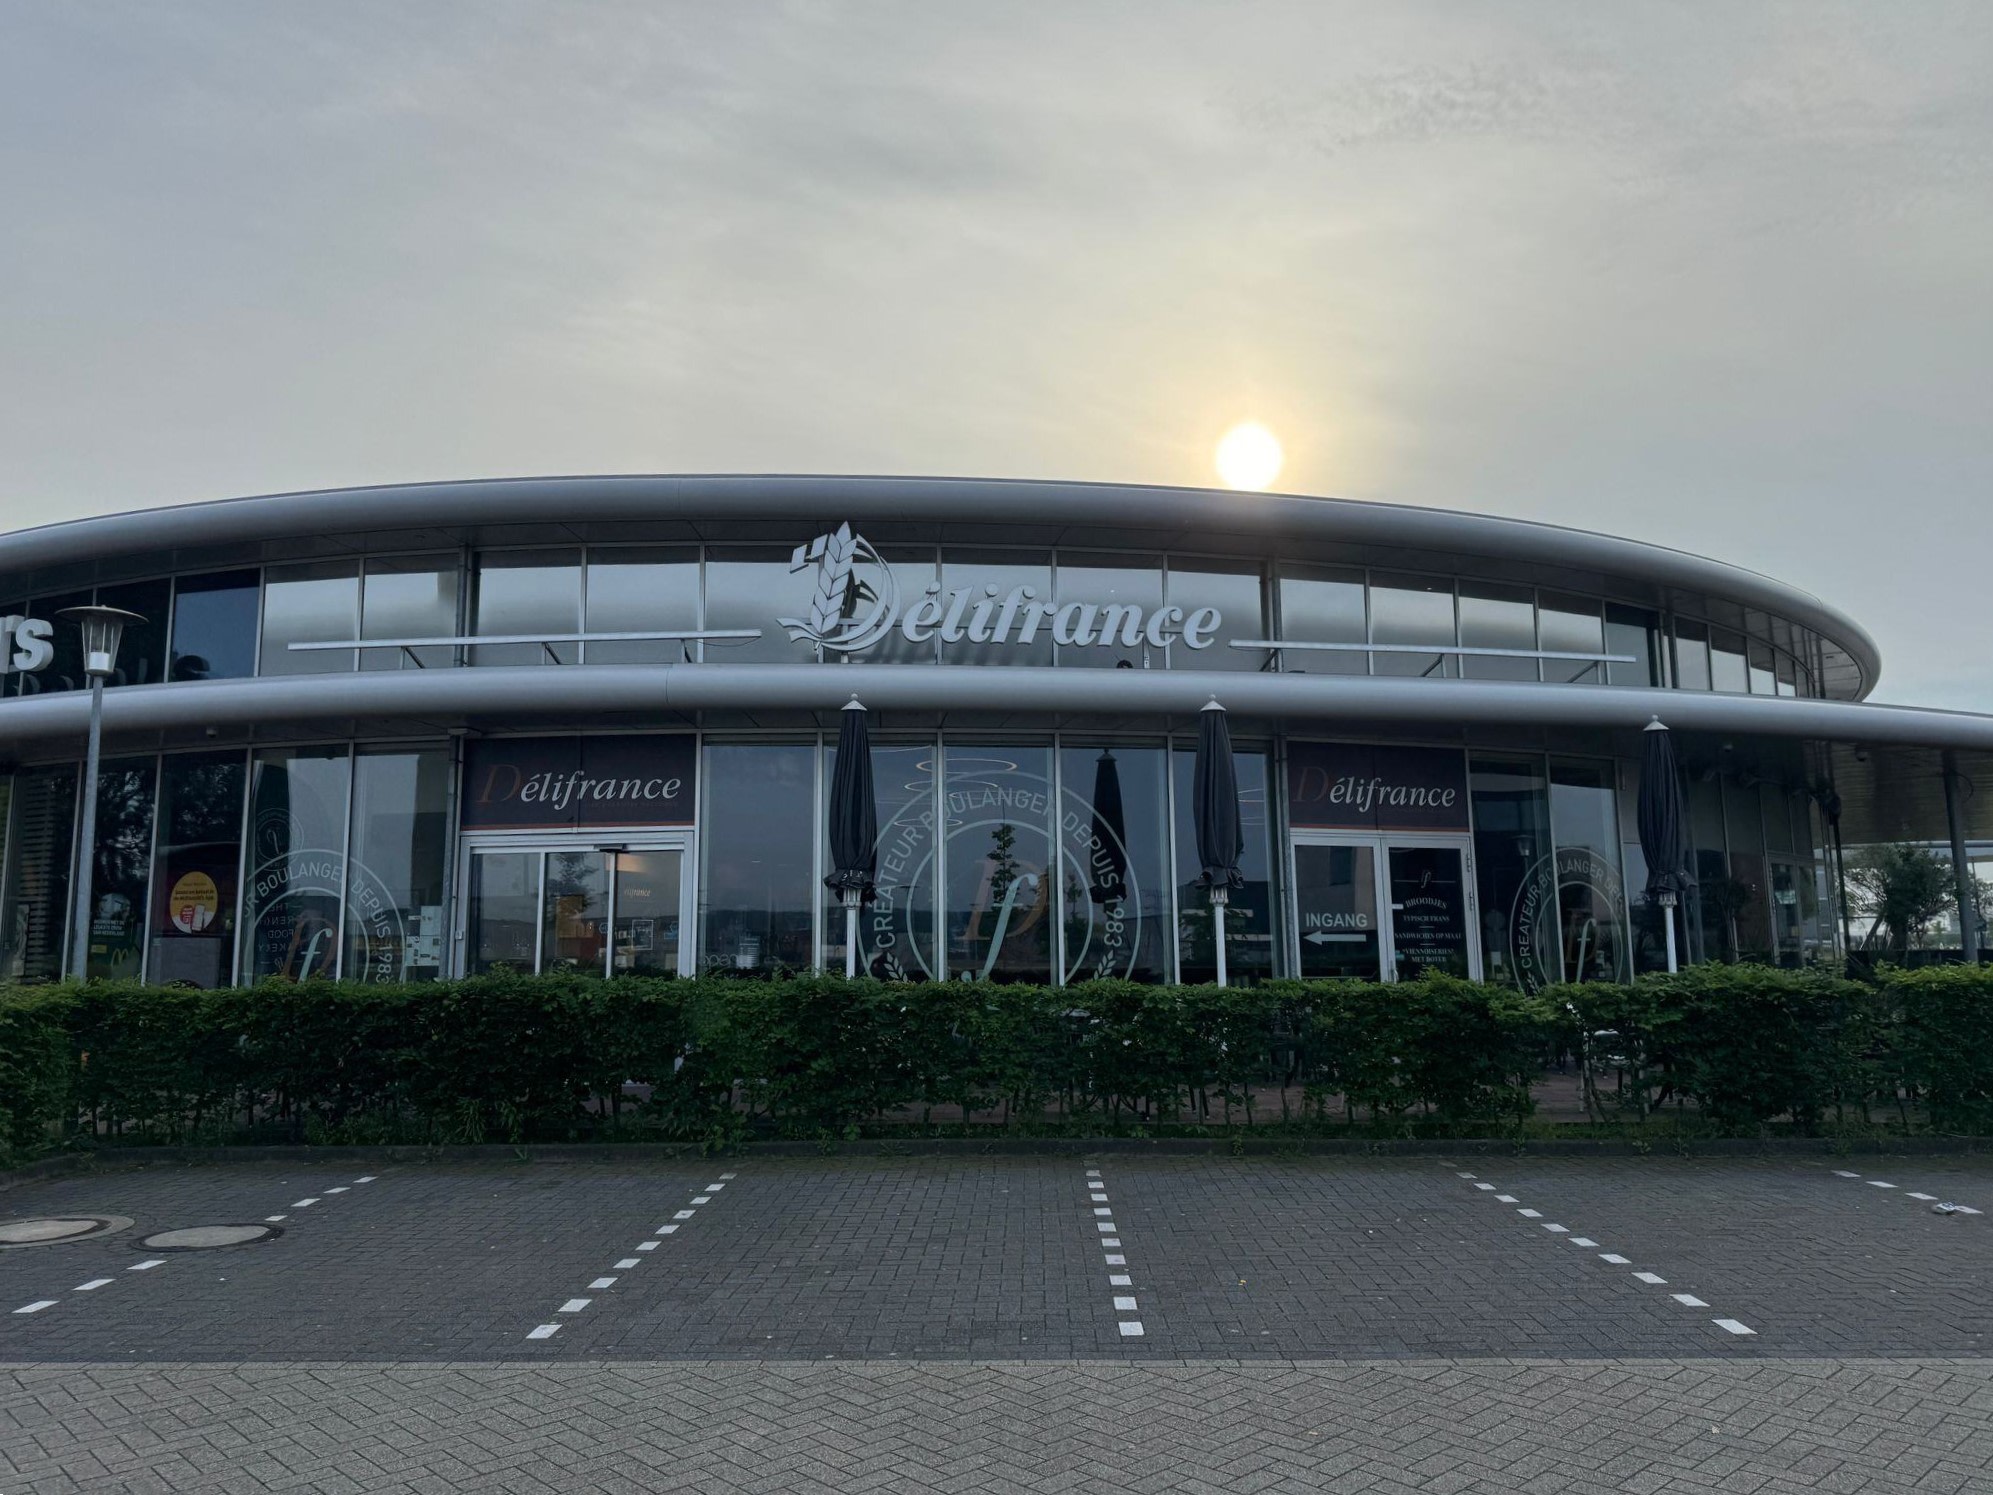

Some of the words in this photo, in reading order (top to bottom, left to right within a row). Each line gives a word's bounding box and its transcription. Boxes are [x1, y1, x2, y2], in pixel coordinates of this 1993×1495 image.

[474, 763, 682, 811] Délifrance
[1292, 765, 1456, 813] Délifrance
[1062, 810, 1120, 889] DEPUIS
[1103, 894, 1125, 948] 1983
[256, 861, 343, 898] BOULANGE
[350, 878, 391, 939] DEPUIS
[375, 944, 393, 984] 1983
[1305, 912, 1368, 928] INGANG
[1404, 897, 1447, 910] BROODJES
[1518, 884, 1542, 969] CREATEUR
